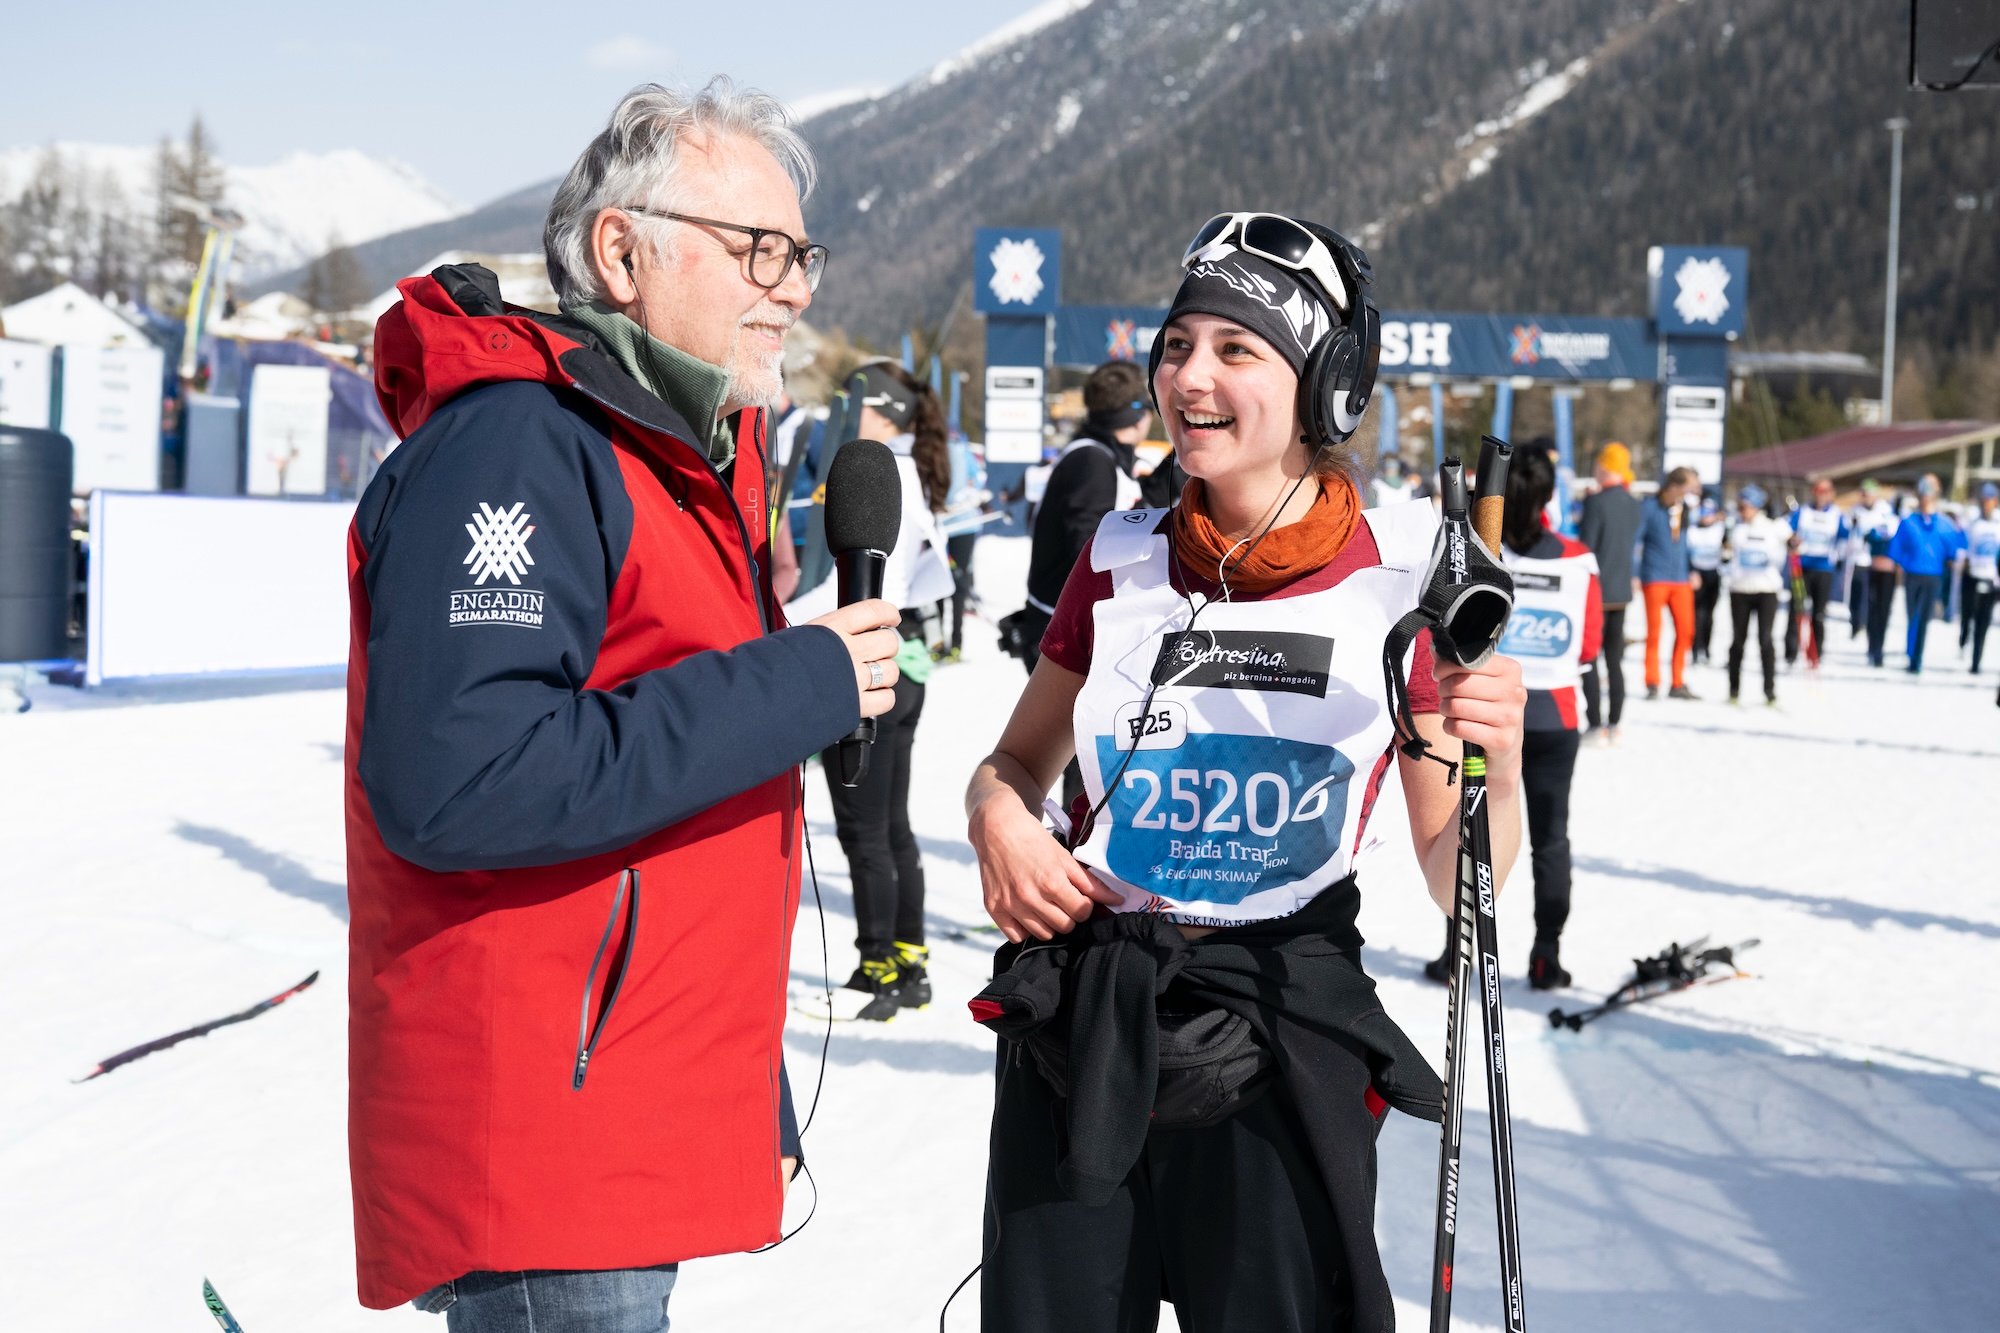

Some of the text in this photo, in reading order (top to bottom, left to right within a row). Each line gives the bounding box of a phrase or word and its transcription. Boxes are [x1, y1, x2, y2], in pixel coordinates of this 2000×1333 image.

[450, 592, 544, 612] ENGADIN
[449, 609, 543, 625] SKIMARATHON
[1224, 672, 1317, 686] piz bernina engadin
[1123, 768, 1335, 837] 25206
[1168, 840, 1222, 860] Braida
[1165, 868, 1212, 881] ENGADIN
[1494, 1033, 1500, 1041] 70
[1495, 1047, 1503, 1073] CARBON
[1445, 1158, 1458, 1235] VIKING
